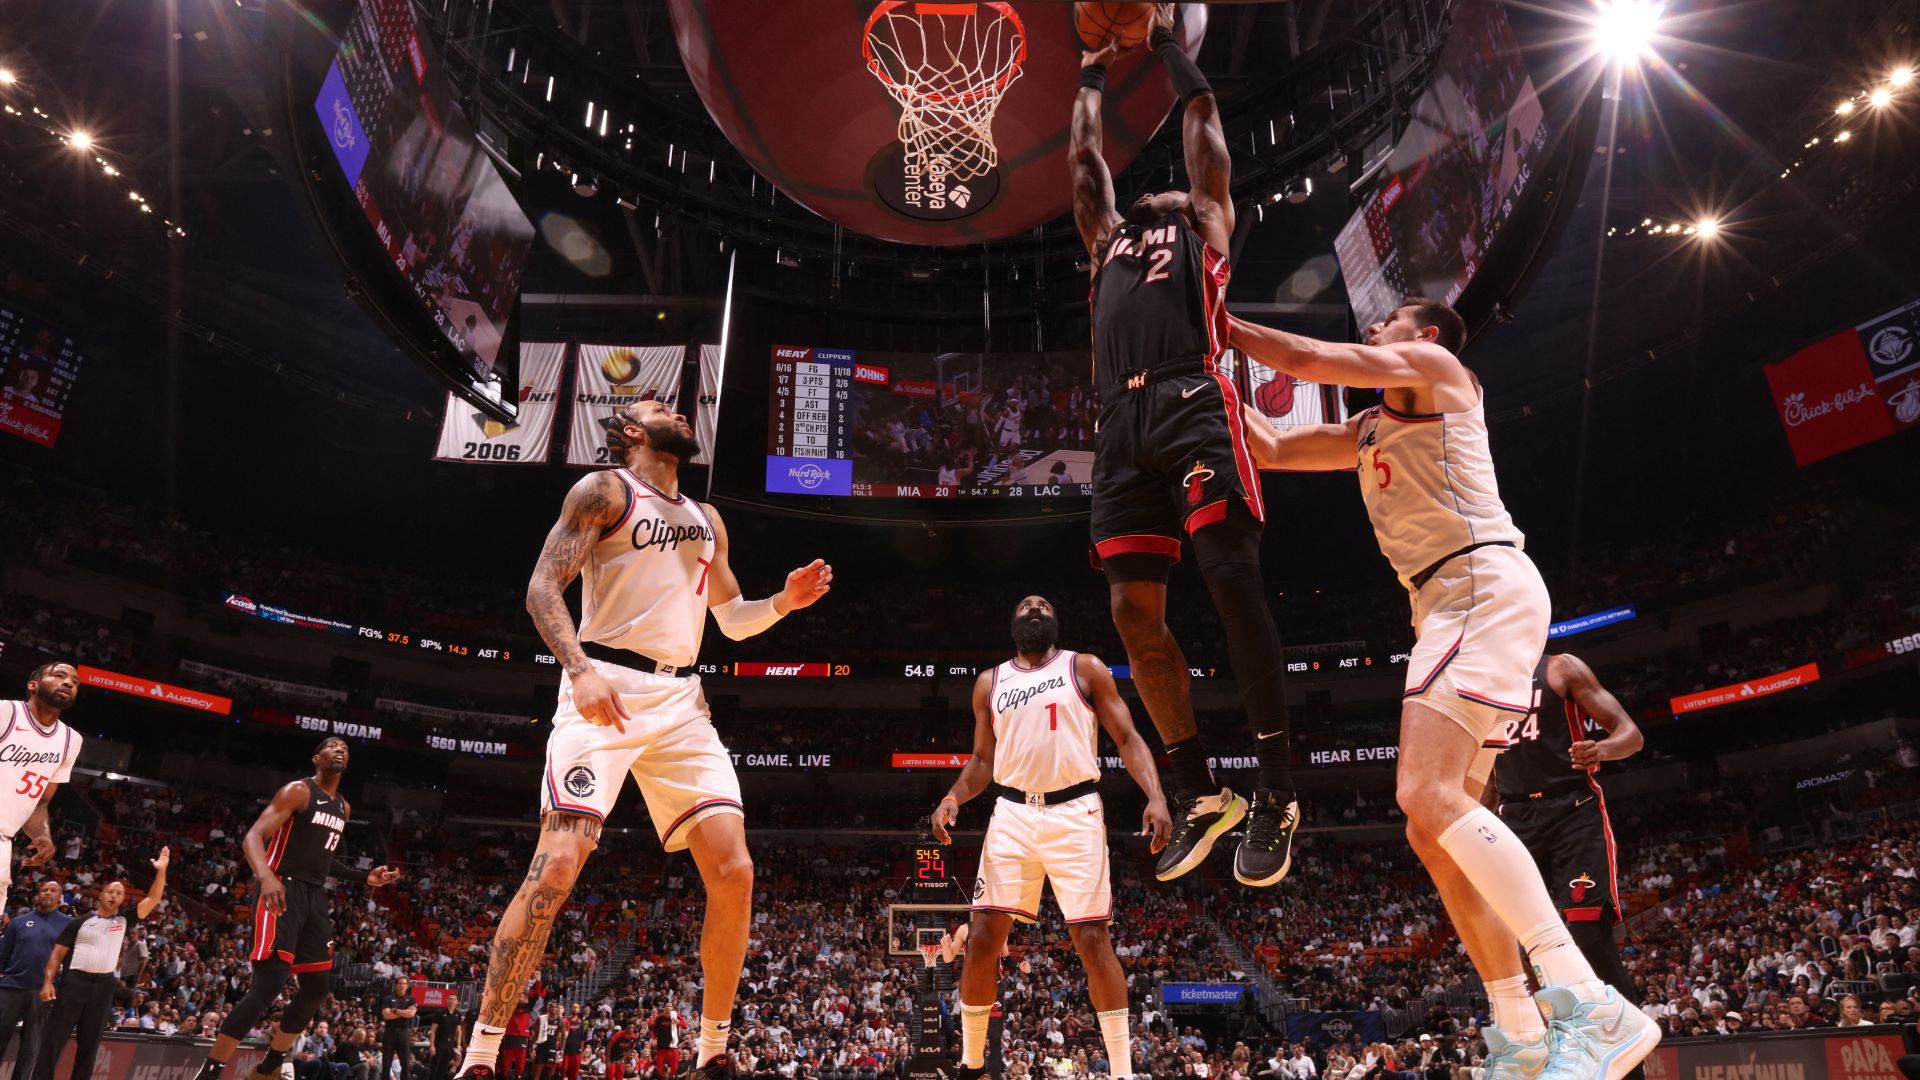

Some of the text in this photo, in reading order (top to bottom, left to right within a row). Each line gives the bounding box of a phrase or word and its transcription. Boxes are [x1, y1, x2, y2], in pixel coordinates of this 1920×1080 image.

[1513, 163, 1531, 198] LAC
[376, 220, 407, 273] MIA 20
[1146, 249, 1172, 284] 2
[1466, 262, 1476, 280] 20
[1445, 284, 1462, 308] MIA
[434, 308, 465, 352] 28 LAC
[777, 349, 851, 361] HEAT CLIPPERS
[808, 365, 819, 374] FG
[855, 367, 886, 382] JOHNS
[809, 377, 823, 386] PTS
[776, 387, 849, 401] 4/5 FT 4/5
[779, 399, 845, 412] 3 AST 5
[1784, 383, 1875, 427] Chick-fil-A
[0, 405, 50, 442] hick-fil-A
[779, 411, 844, 423] 4 OFF REB 2
[778, 422, 784, 432] 2
[806, 424, 815, 433] CH
[816, 425, 828, 433] PTS
[778, 434, 843, 447] 5 TO 3
[463, 442, 521, 461] 2006
[835, 449, 845, 459] 16
[789, 468, 830, 481] Hard Rock
[897, 486, 921, 497] MIA
[935, 486, 949, 497] 20
[971, 487, 988, 496] 54.7
[1009, 486, 1022, 497] 28
[1034, 485, 1060, 497] LAC
[632, 518, 712, 553] Clippers
[696, 557, 711, 596] 7
[358, 626, 556, 665] FG% 37.5 3P% 14.3 AST 3 REB
[1893, 633, 1920, 656] 560
[699, 664, 716, 674] FLS
[722, 664, 729, 674] 3
[766, 664, 804, 676] HEAT
[834, 664, 851, 676] 20
[949, 667, 968, 675] QTR
[1208, 668, 1216, 677] 7
[1287, 661, 1308, 672] REB
[1312, 661, 1319, 670] 9
[1338, 657, 1359, 668] AST
[1364, 657, 1371, 666] 5
[1389, 652, 1411, 664] 3P%
[89, 675, 214, 709] LISTEN FREE ON Audacy
[997, 676, 1066, 714] Clippers
[1683, 675, 1802, 710] LISTEN FREE ON Audacy
[301, 716, 329, 732] 560
[1045, 703, 1057, 731] 1
[1505, 713, 1540, 745] 24
[431, 736, 457, 751] 560
[0, 743, 60, 767] Clippers
[799, 754, 831, 767] LIVE
[1310, 749, 1351, 764] HEAR
[15, 770, 49, 799] 55
[546, 813, 578, 833] JUST
[324, 832, 340, 852] 13
[916, 849, 941, 860] 54.5
[918, 860, 945, 879] 24
[1180, 987, 1238, 1000] ticketmaster
[1840, 1040, 1895, 1073] PAPA
[909, 1071, 938, 1079] American
